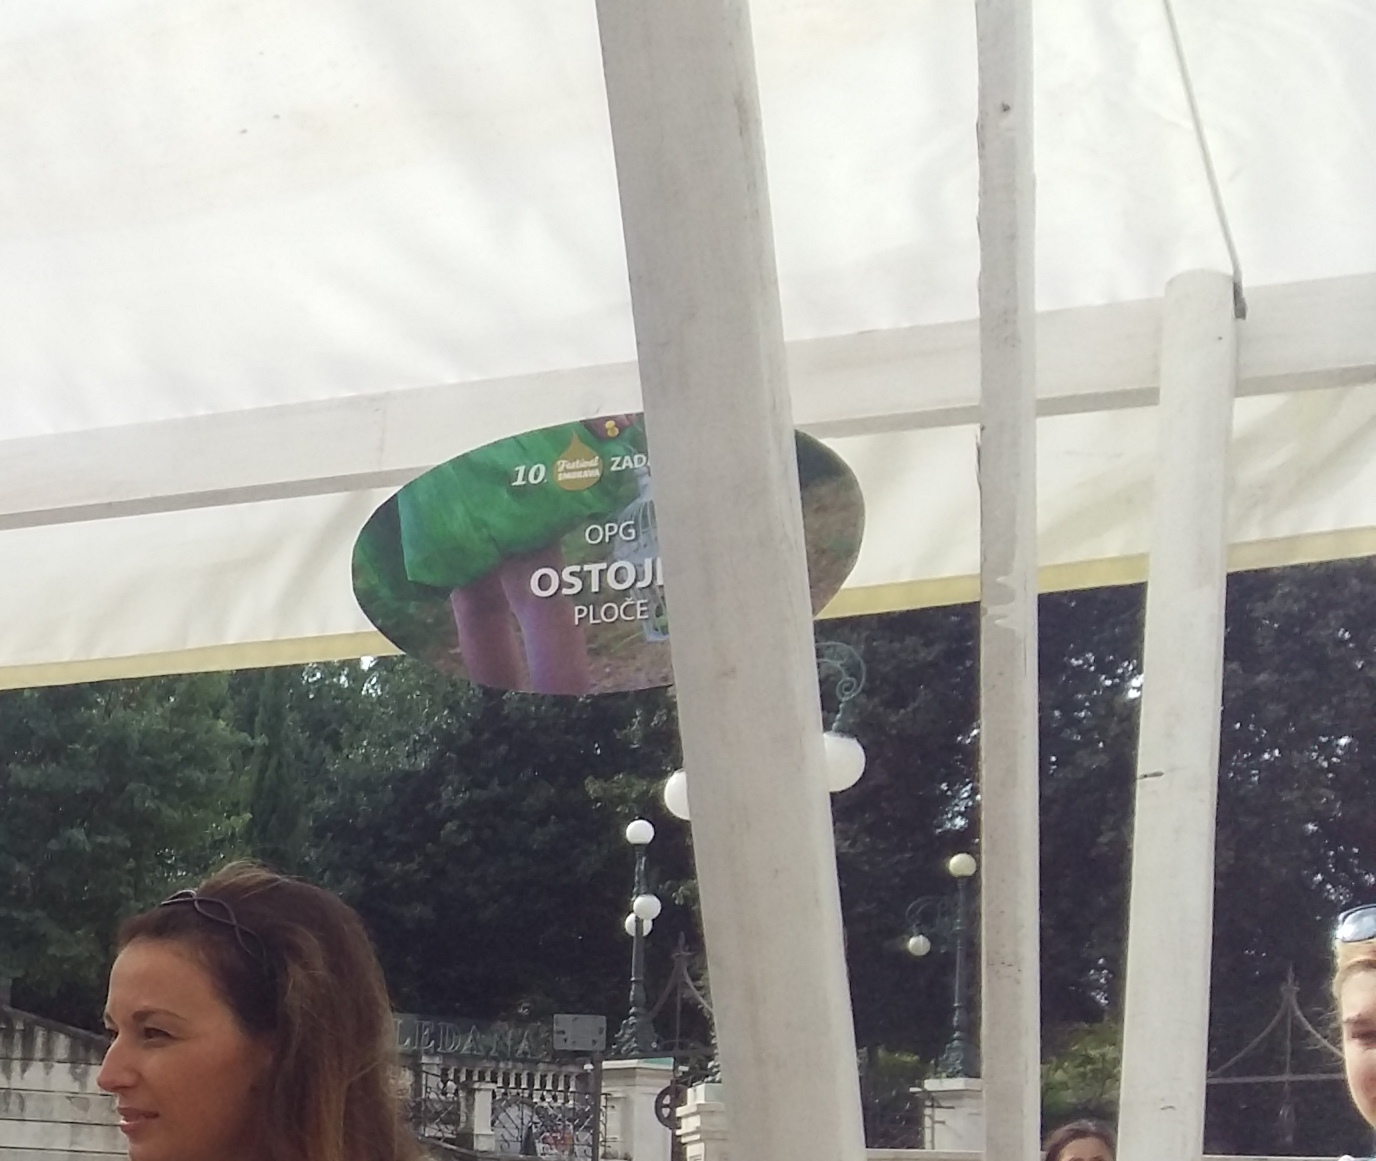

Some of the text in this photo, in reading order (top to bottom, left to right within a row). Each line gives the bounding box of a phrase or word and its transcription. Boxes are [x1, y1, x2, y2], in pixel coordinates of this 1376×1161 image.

[610, 454, 649, 471] ZAD
[585, 521, 636, 545] OPG
[530, 556, 664, 598] OSTOJI
[574, 597, 649, 625] PLOČE
